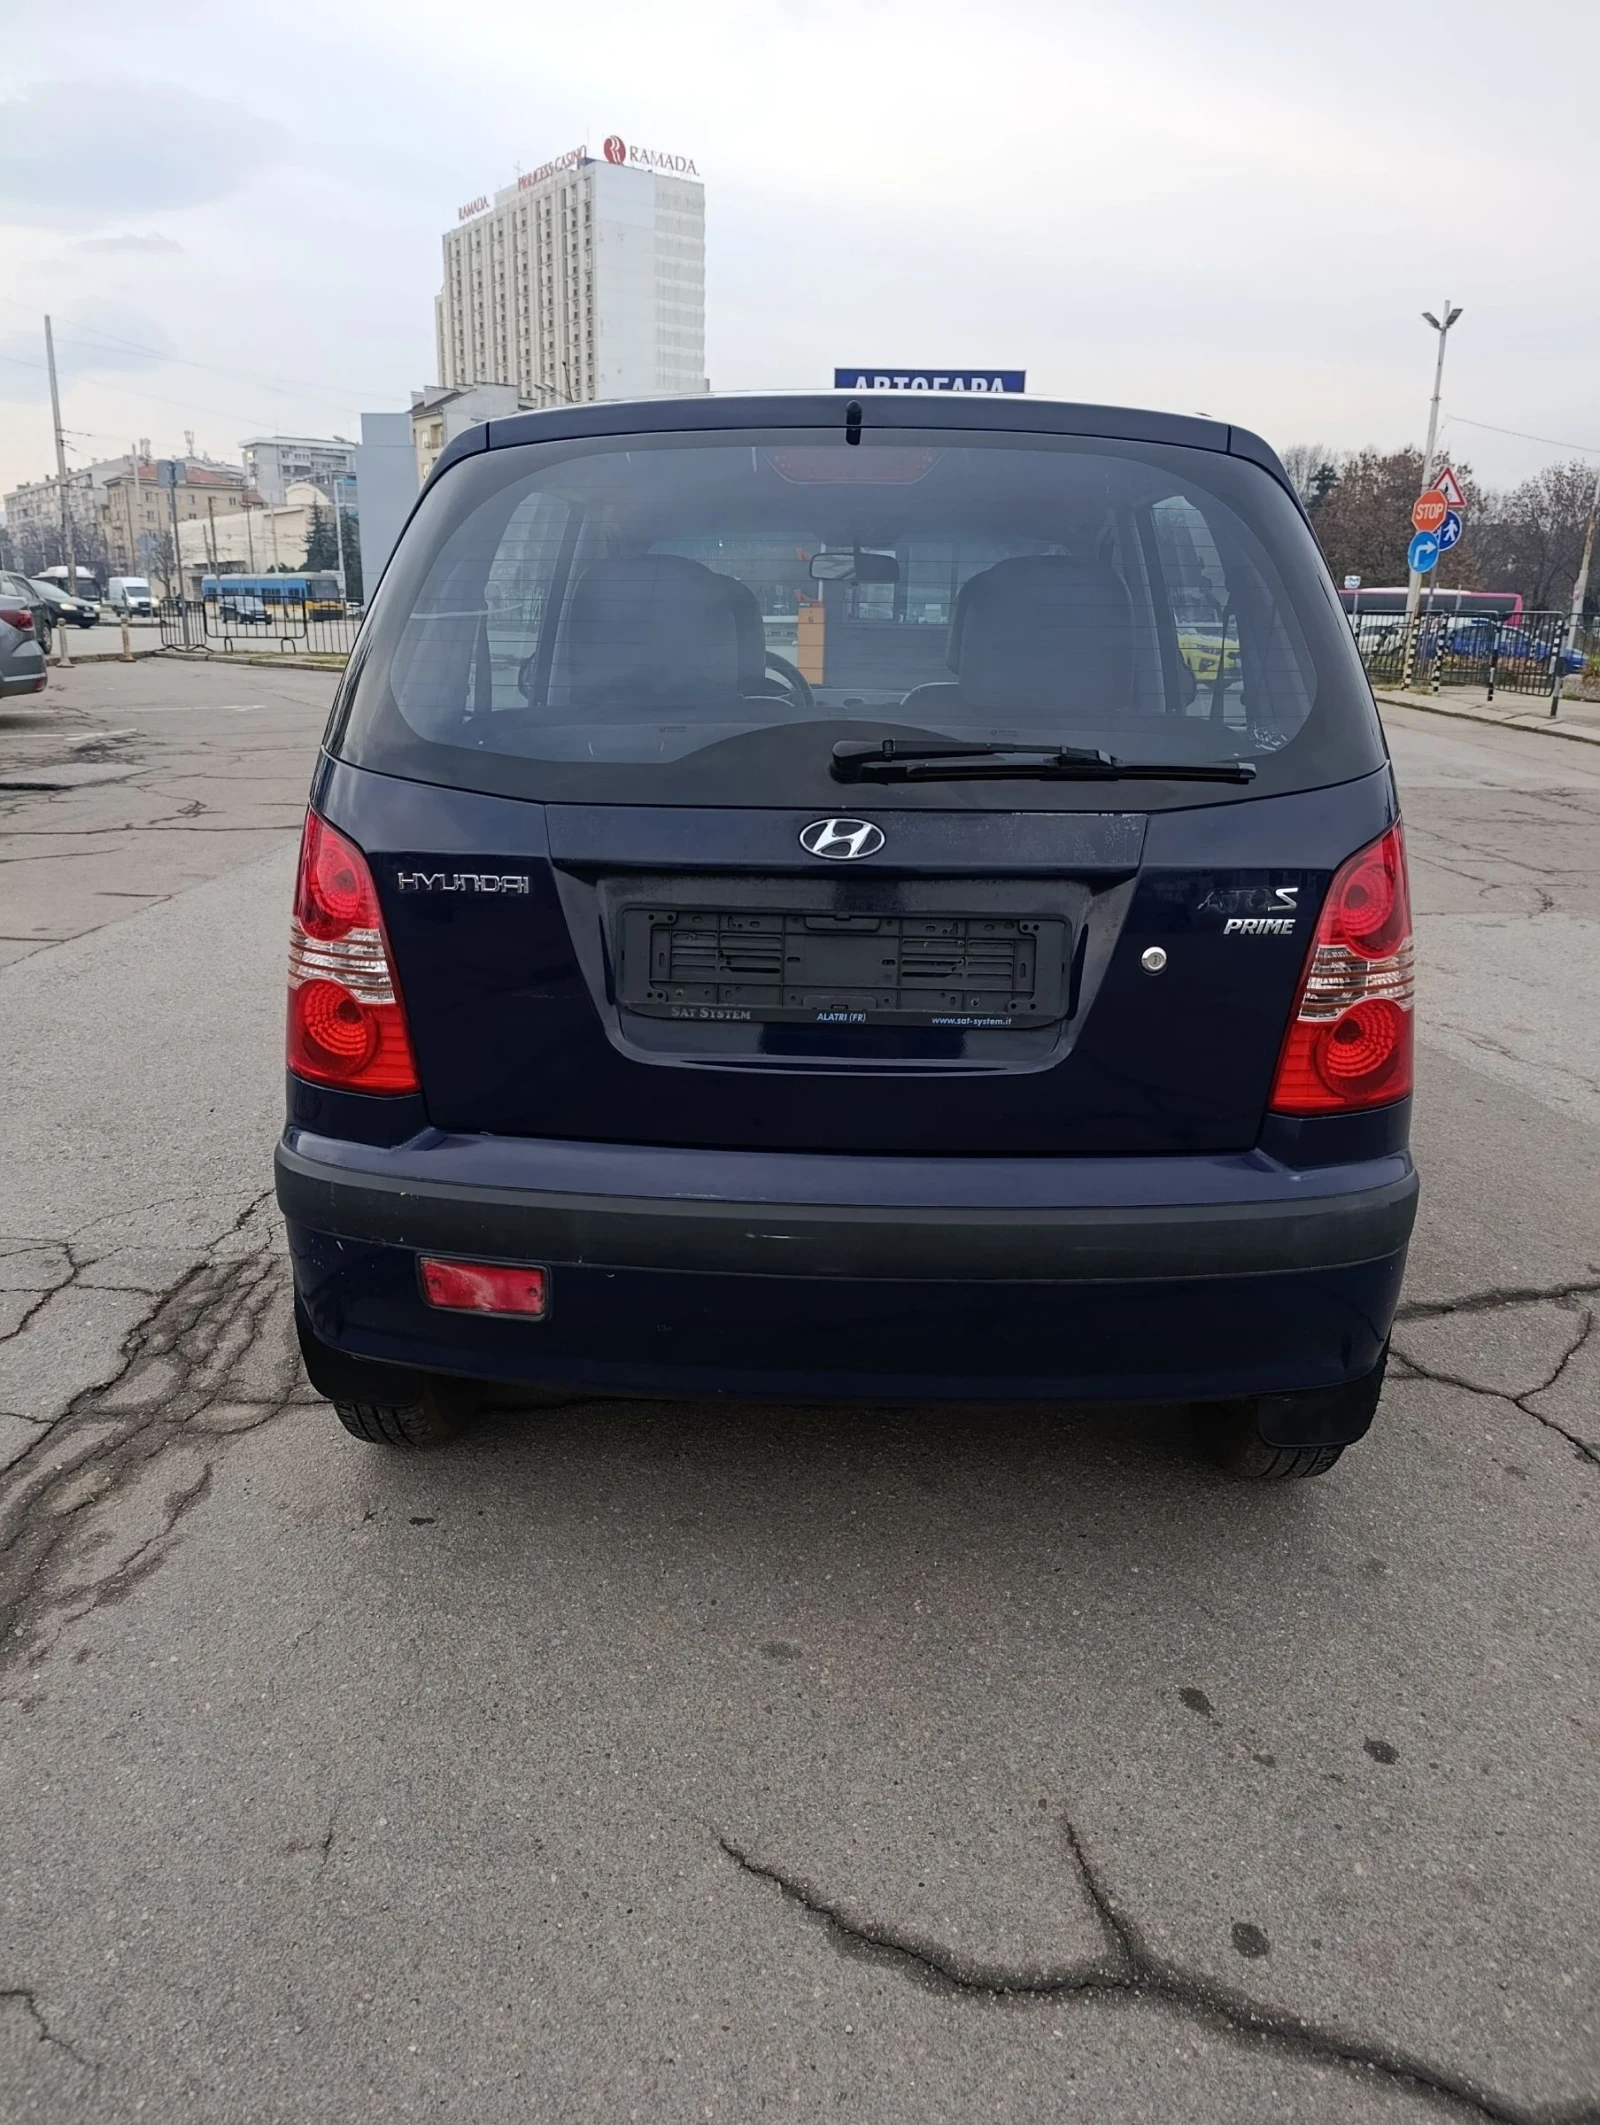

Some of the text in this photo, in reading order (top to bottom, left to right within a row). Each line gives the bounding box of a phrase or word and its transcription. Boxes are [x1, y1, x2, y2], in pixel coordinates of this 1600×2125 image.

[555, 145, 587, 172] CASINO
[629, 145, 698, 176] RAMADA
[1415, 503, 1444, 520] STOP
[397, 872, 530, 895] HYUNDAI
[1223, 918, 1296, 935] PRIME
[671, 1006, 752, 1020] SAT SYSTEM
[816, 1012, 867, 1023] ALATRI (FR)
[931, 1016, 1012, 1027] www.sat-system.it
